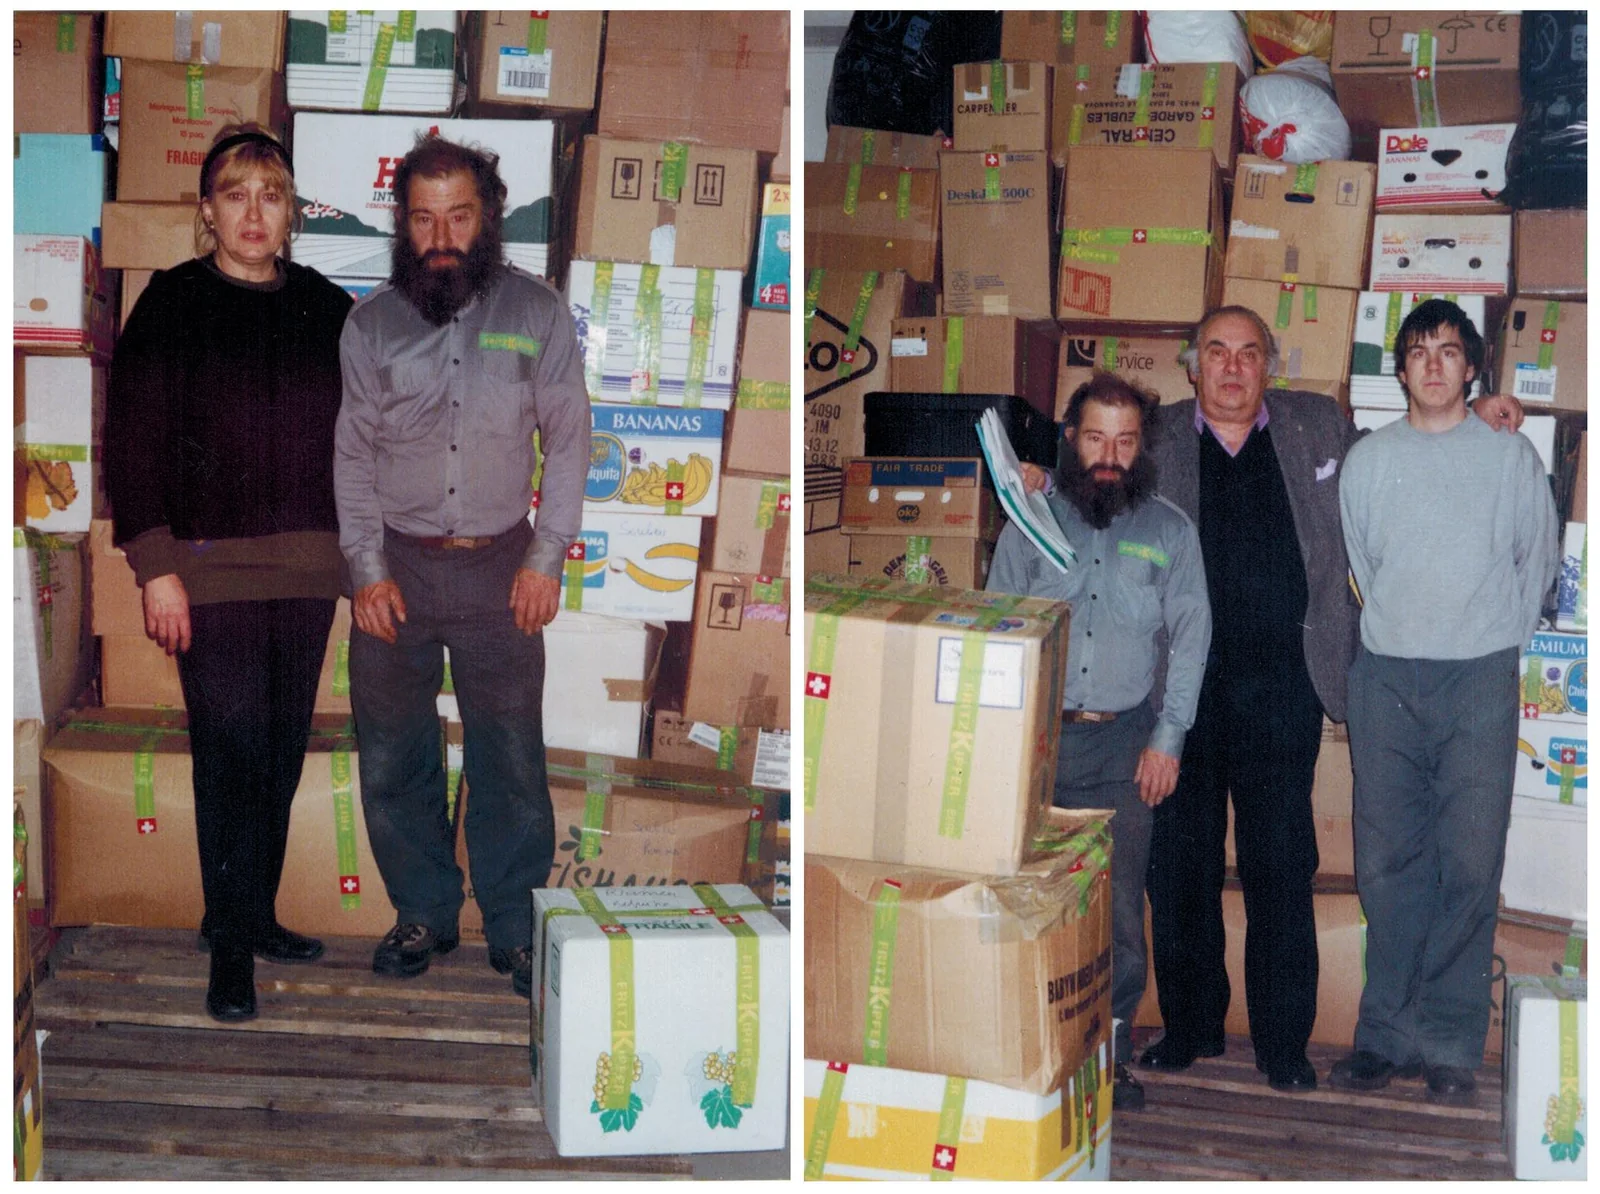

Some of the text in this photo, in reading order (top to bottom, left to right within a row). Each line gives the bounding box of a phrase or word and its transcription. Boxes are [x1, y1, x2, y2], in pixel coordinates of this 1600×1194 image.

[957, 103, 1018, 114] CARPENER
[1087, 111, 1195, 122] GARDE-EUBLES
[1386, 134, 1428, 152] Dole
[1385, 156, 1421, 164] BANANAS
[1002, 188, 1035, 199] 500C
[761, 283, 772, 302] 4
[810, 402, 841, 420] 4090
[613, 413, 702, 432] BANANAS
[877, 464, 944, 472] FAIR TRADE
[1527, 639, 1585, 655] EMIUM
